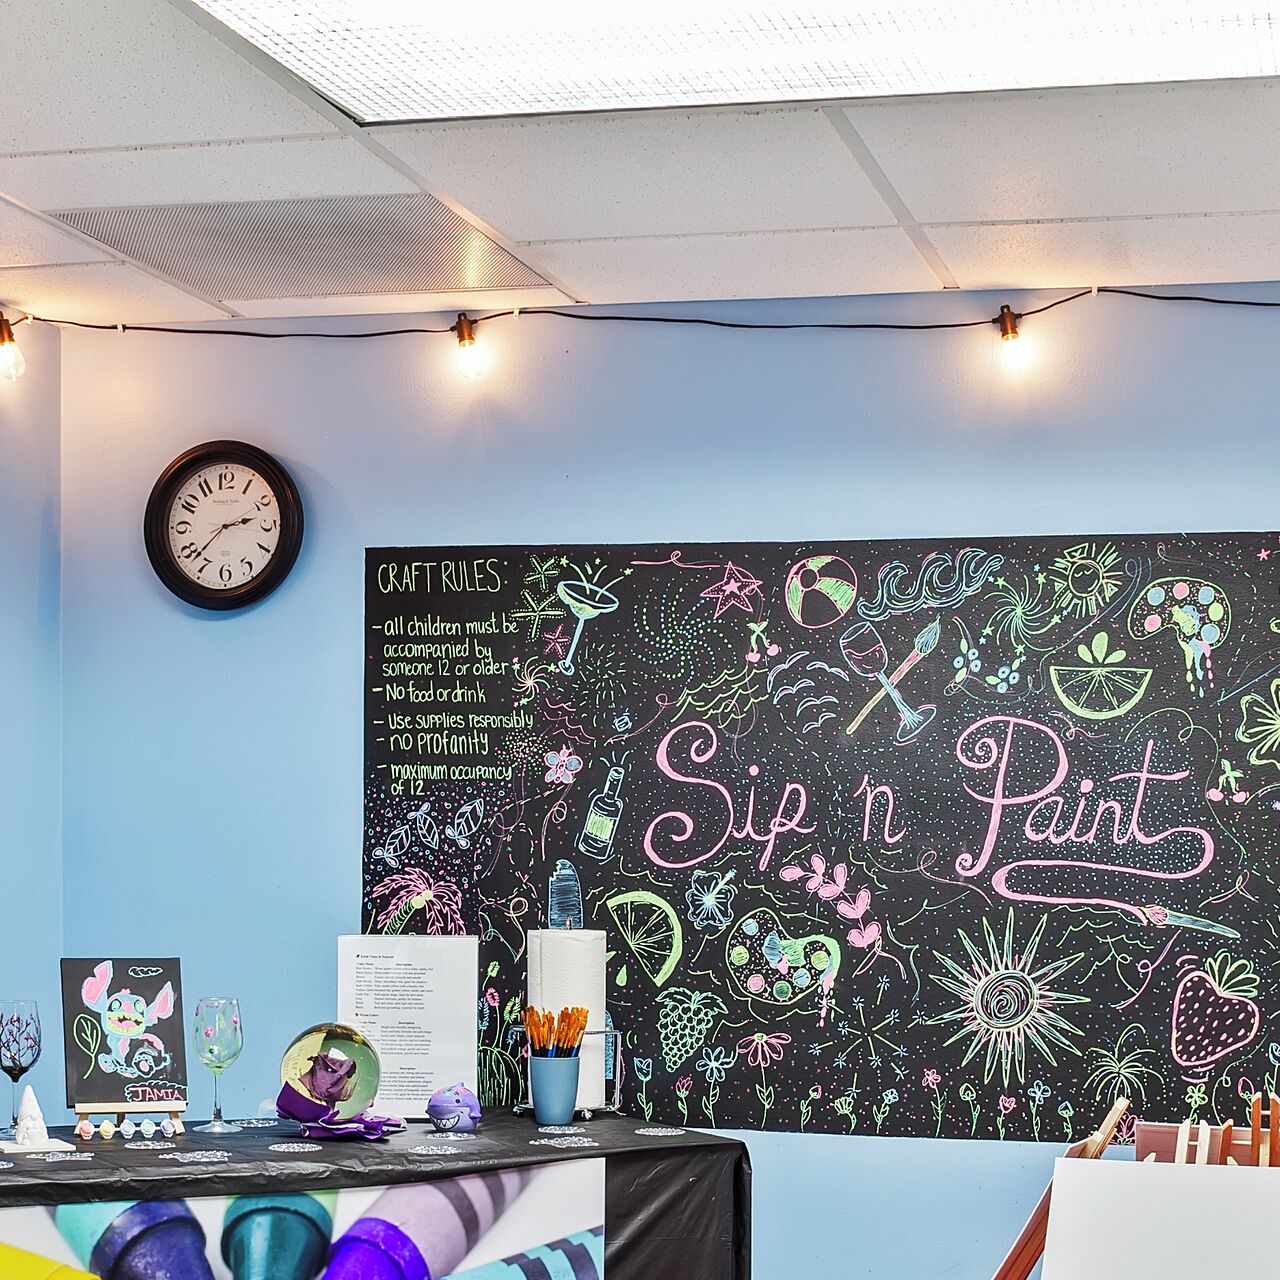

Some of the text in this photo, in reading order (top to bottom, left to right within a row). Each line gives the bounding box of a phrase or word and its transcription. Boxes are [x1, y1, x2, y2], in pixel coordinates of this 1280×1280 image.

[198, 477, 214, 497] 11
[218, 471, 235, 490] 12
[242, 479, 254, 495] 1
[181, 493, 201, 515] 10
[253, 494, 272, 512] 2
[175, 520, 193, 535] 9
[259, 518, 278, 533] 3
[180, 541, 199, 560] 8
[256, 541, 271, 559] 4
[197, 557, 213, 574] 7
[219, 563, 233, 583] 6
[240, 556, 254, 576] 5
[377, 562, 437, 593] CRAFT
[384, 612, 520, 636] all children must be
[383, 638, 492, 666] accompanied by
[382, 660, 510, 677] someone 12 or older
[386, 681, 487, 703] No food or drink
[388, 710, 534, 730] Use supplies responsibly
[390, 731, 489, 755] no profanity
[390, 763, 513, 781] maximum occupancy
[391, 780, 426, 796] of 12
[643, 720, 817, 872] Sip
[955, 714, 1216, 884] Paint
[128, 1086, 184, 1102] JAMIA
